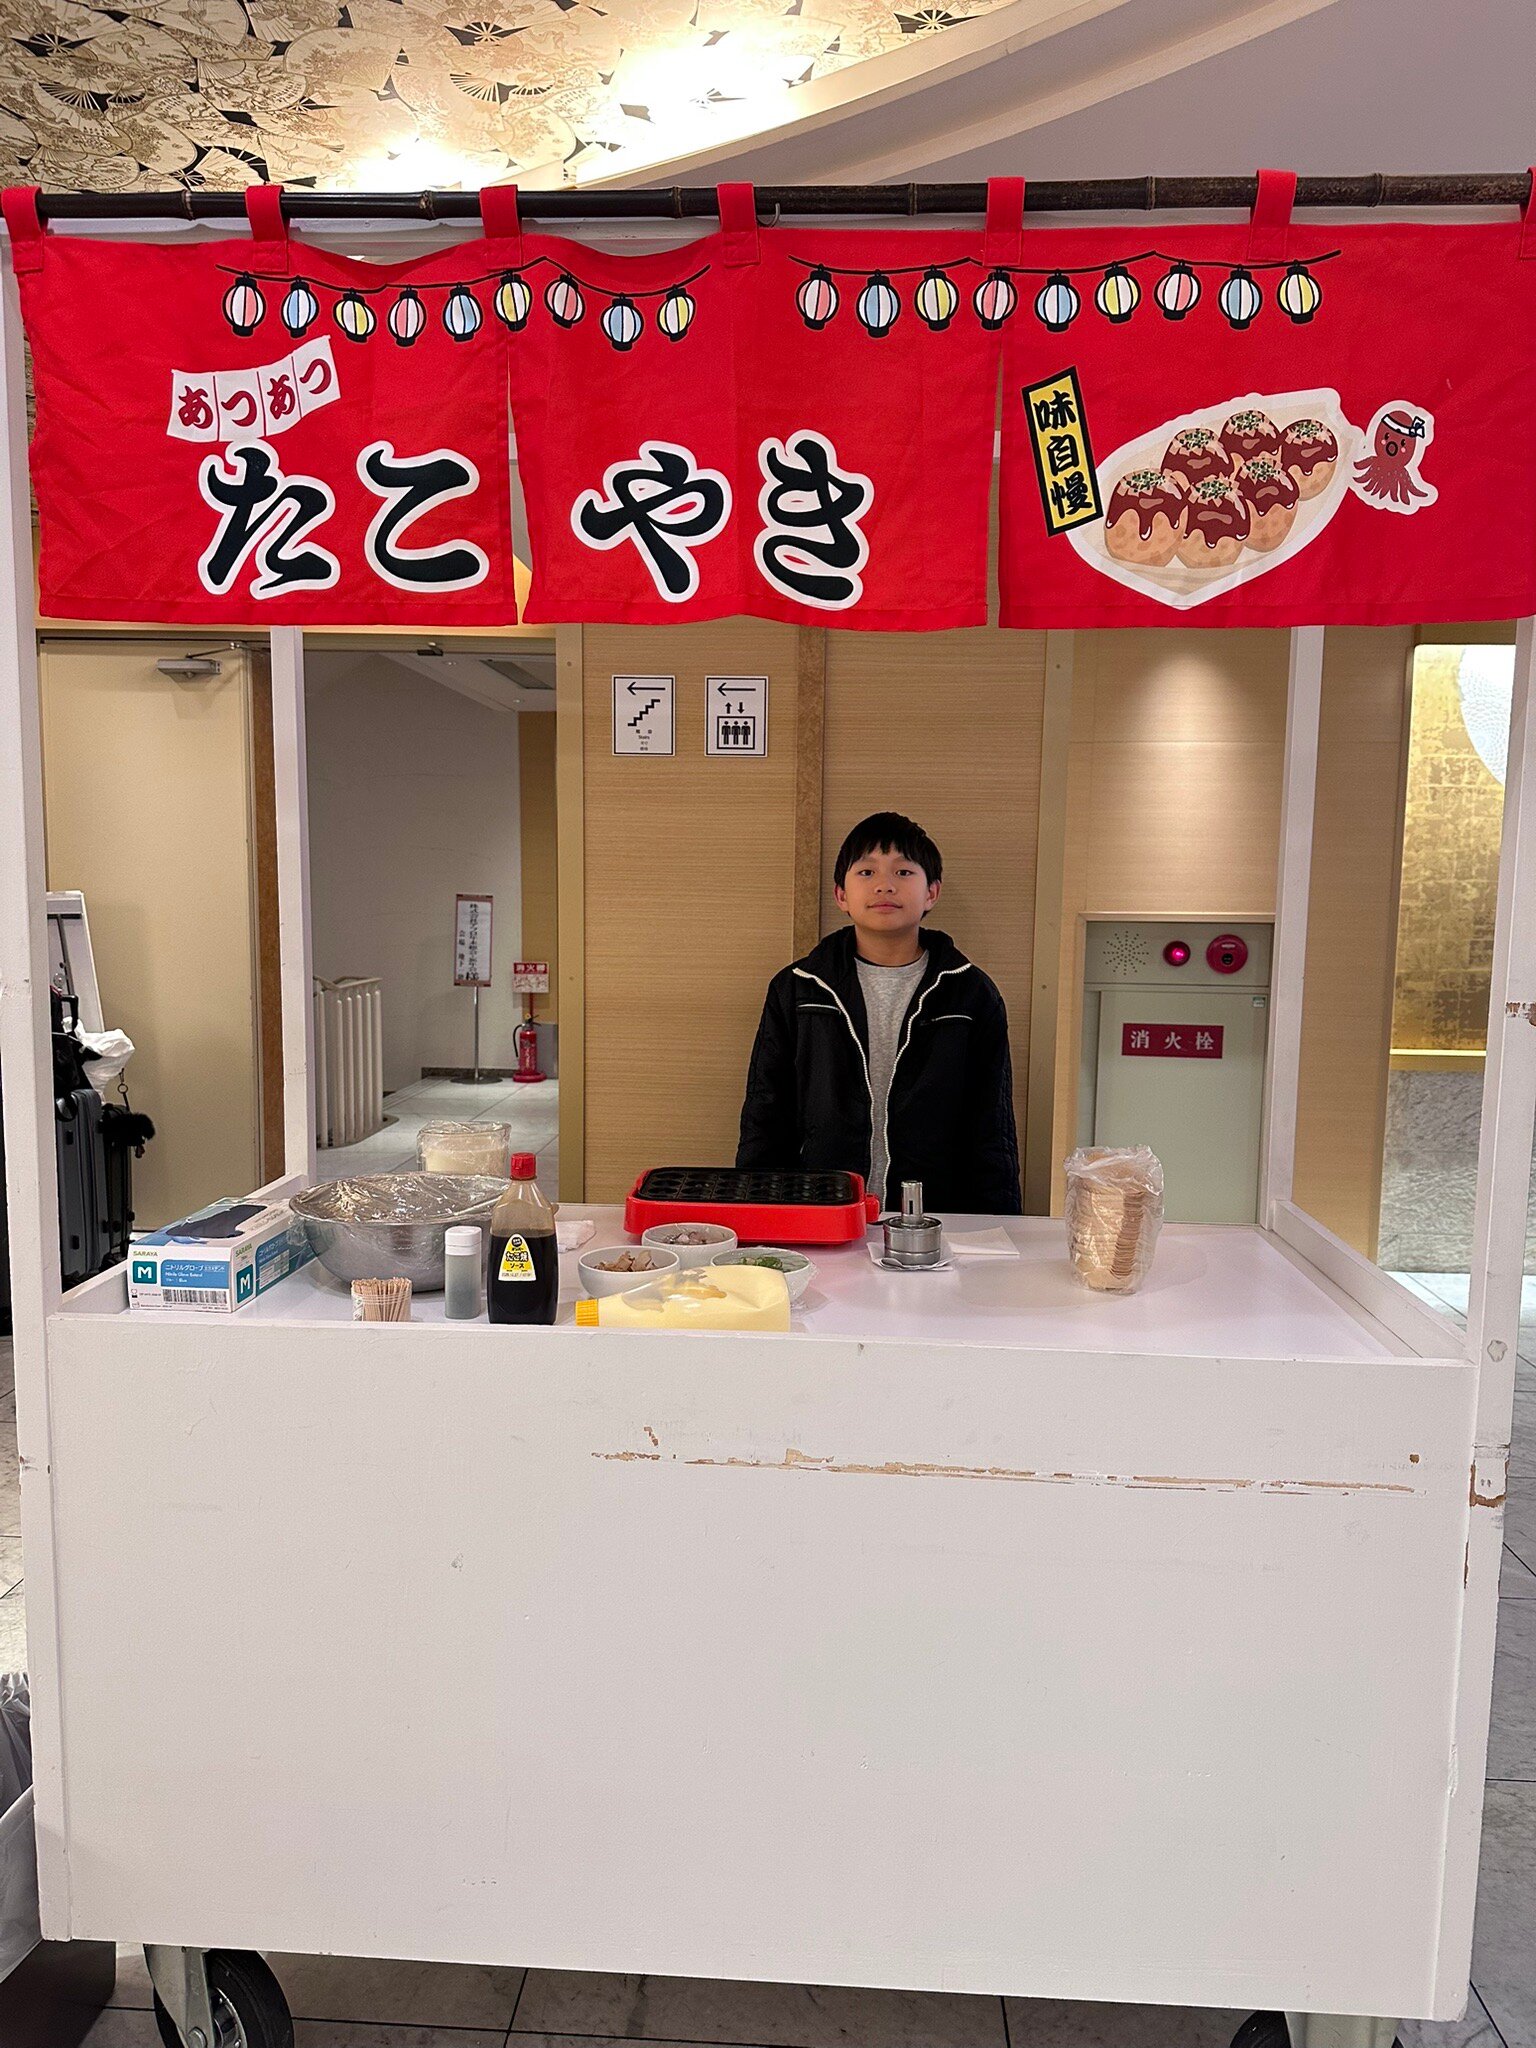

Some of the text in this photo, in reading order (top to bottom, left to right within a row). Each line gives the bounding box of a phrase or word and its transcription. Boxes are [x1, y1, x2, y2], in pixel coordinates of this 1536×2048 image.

[177, 355, 332, 430] あつあつ
[1034, 389, 1094, 519] 味自慢
[205, 438, 866, 603] たこやき
[1131, 1030, 1214, 1050] 消火栓
[137, 1266, 152, 1279] M
[165, 1264, 204, 1272] ニトリルグローブ
[240, 1273, 251, 1294] M
